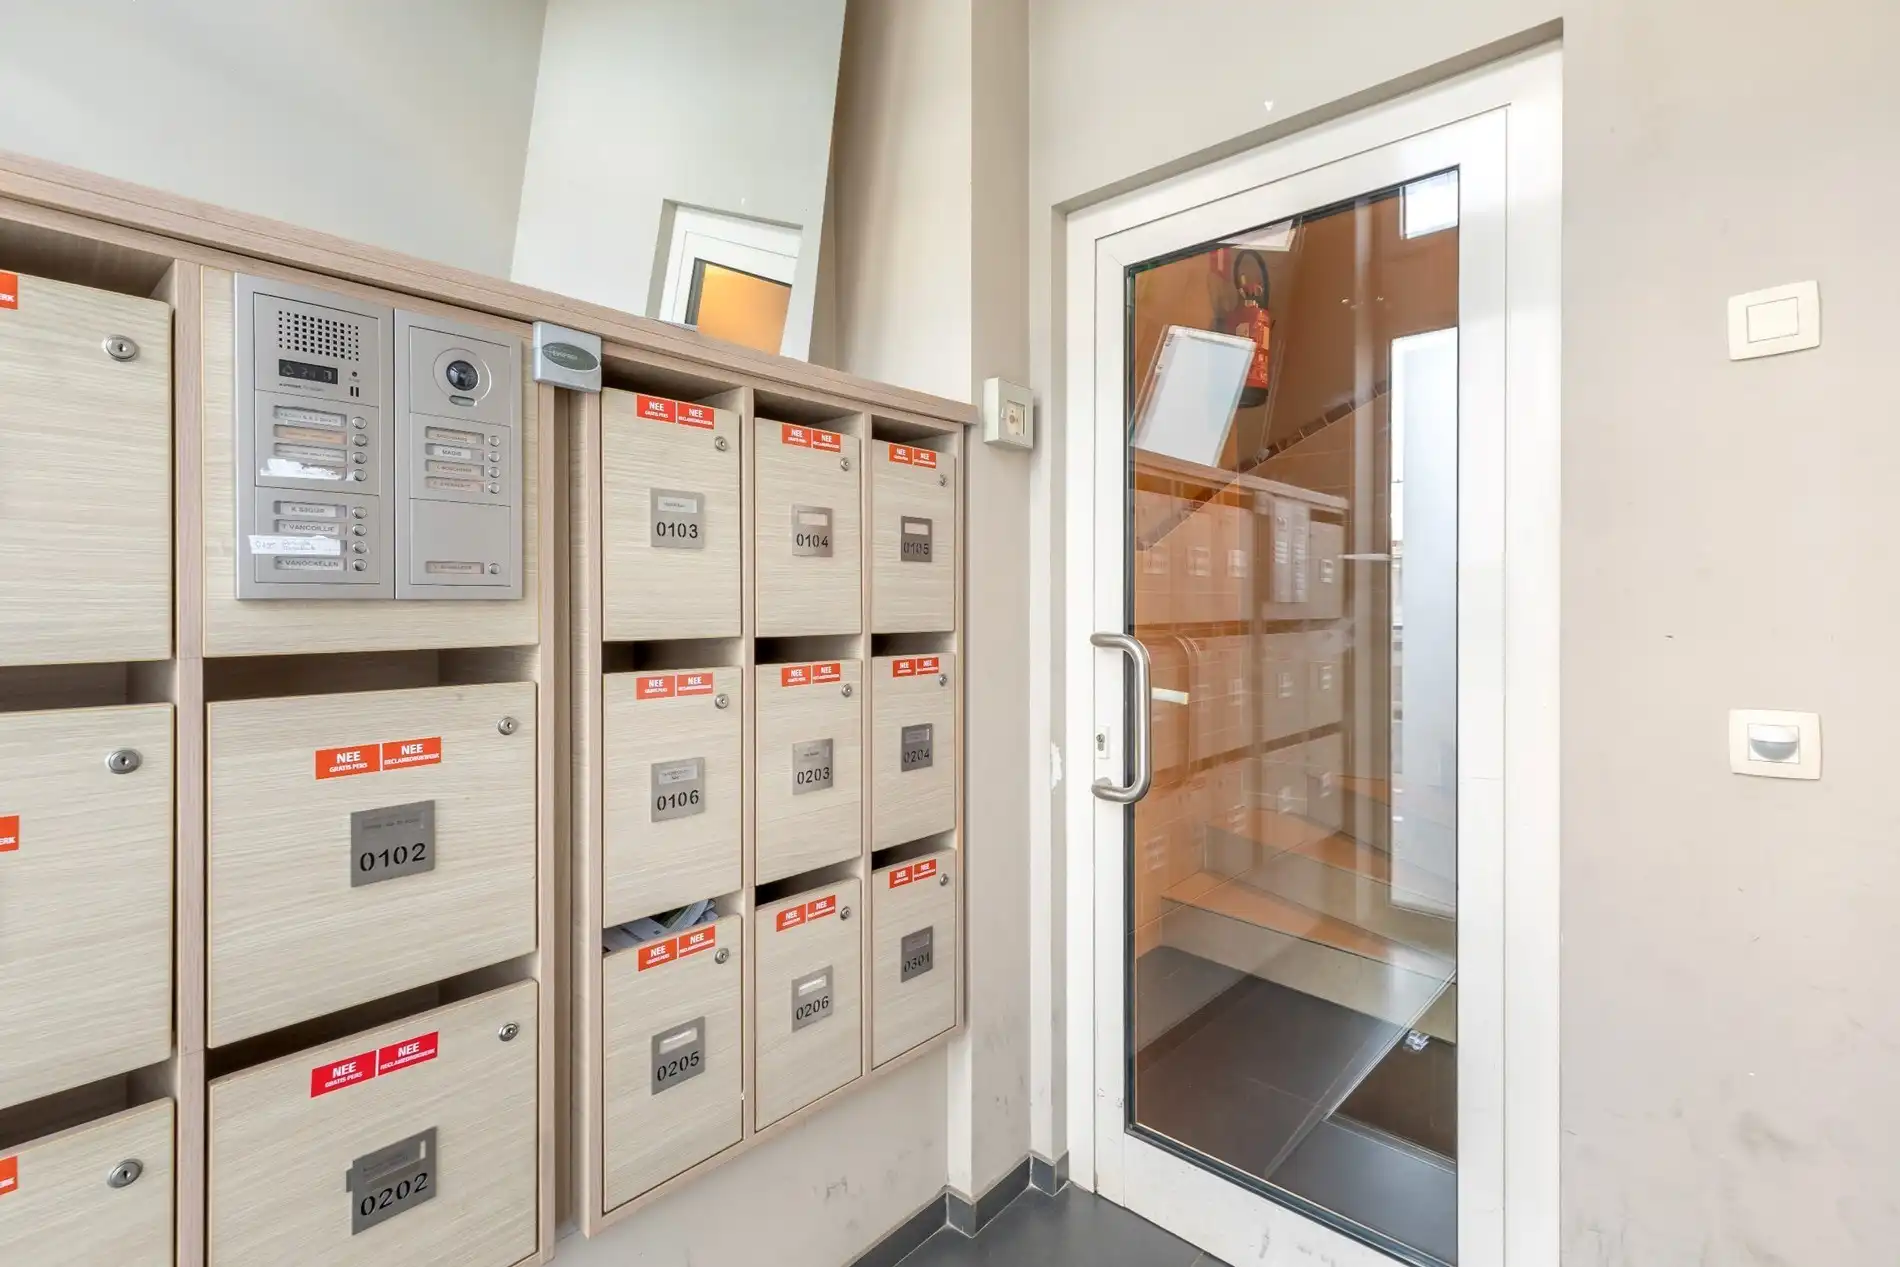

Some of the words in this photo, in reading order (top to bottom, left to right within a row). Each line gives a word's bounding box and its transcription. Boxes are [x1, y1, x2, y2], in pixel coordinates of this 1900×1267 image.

[649, 401, 664, 411] NEE
[689, 408, 703, 418] NEE
[656, 522, 698, 538] 0103
[796, 534, 828, 547] 0104
[904, 542, 928, 555] 0105
[649, 679, 664, 688] NEE
[688, 676, 702, 685] NEE
[401, 744, 423, 755] NEE
[904, 748, 930, 763] 0204
[336, 751, 360, 764] NEE
[329, 764, 352, 773] GRATIS
[352, 762, 368, 770] PERS
[797, 767, 830, 784] 0203
[657, 790, 699, 811] 0106
[360, 842, 426, 872] 0102
[690, 933, 704, 944] NEE
[650, 945, 666, 957] NEE
[904, 952, 930, 972] 0301
[796, 996, 828, 1020] 0206
[398, 1042, 420, 1058] NEE
[332, 1062, 356, 1078] NEE
[657, 1050, 700, 1082] 0205
[325, 1076, 346, 1088] GRATIS
[347, 1072, 362, 1081] PERS
[360, 1172, 428, 1216] 0202
